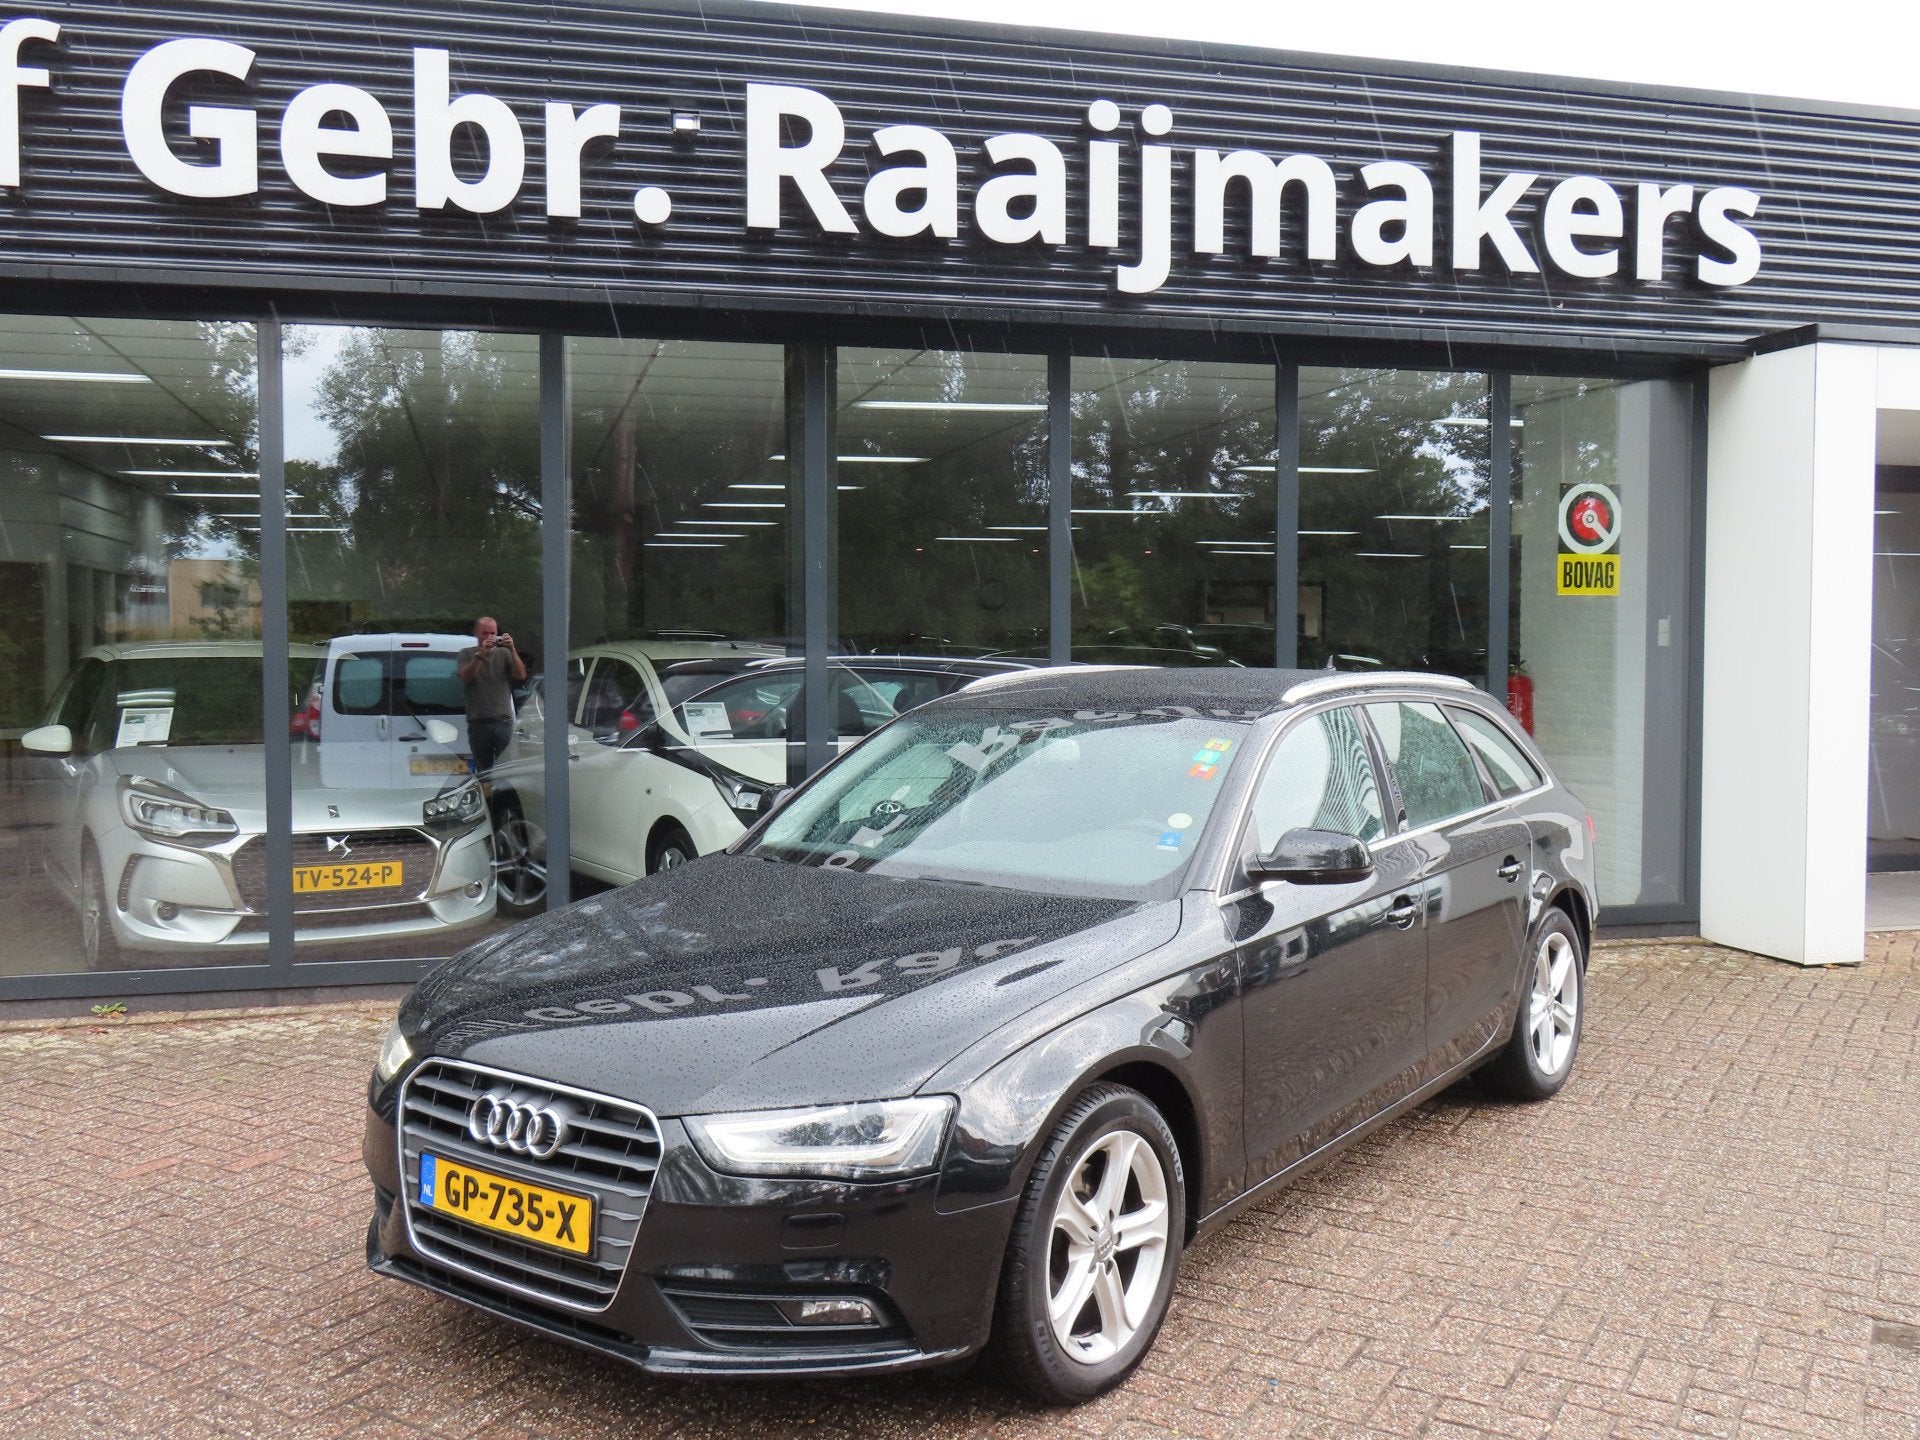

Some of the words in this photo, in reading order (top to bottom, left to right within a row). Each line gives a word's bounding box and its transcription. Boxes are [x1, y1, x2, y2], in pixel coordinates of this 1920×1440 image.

[121, 38, 672, 225] Gebr.
[746, 82, 1762, 293] Raaijmakers
[1563, 561, 1615, 589] BOVAG
[295, 865, 393, 889] TV-524-P
[422, 1183, 434, 1198] NL
[444, 1169, 576, 1243] GP-735-X
